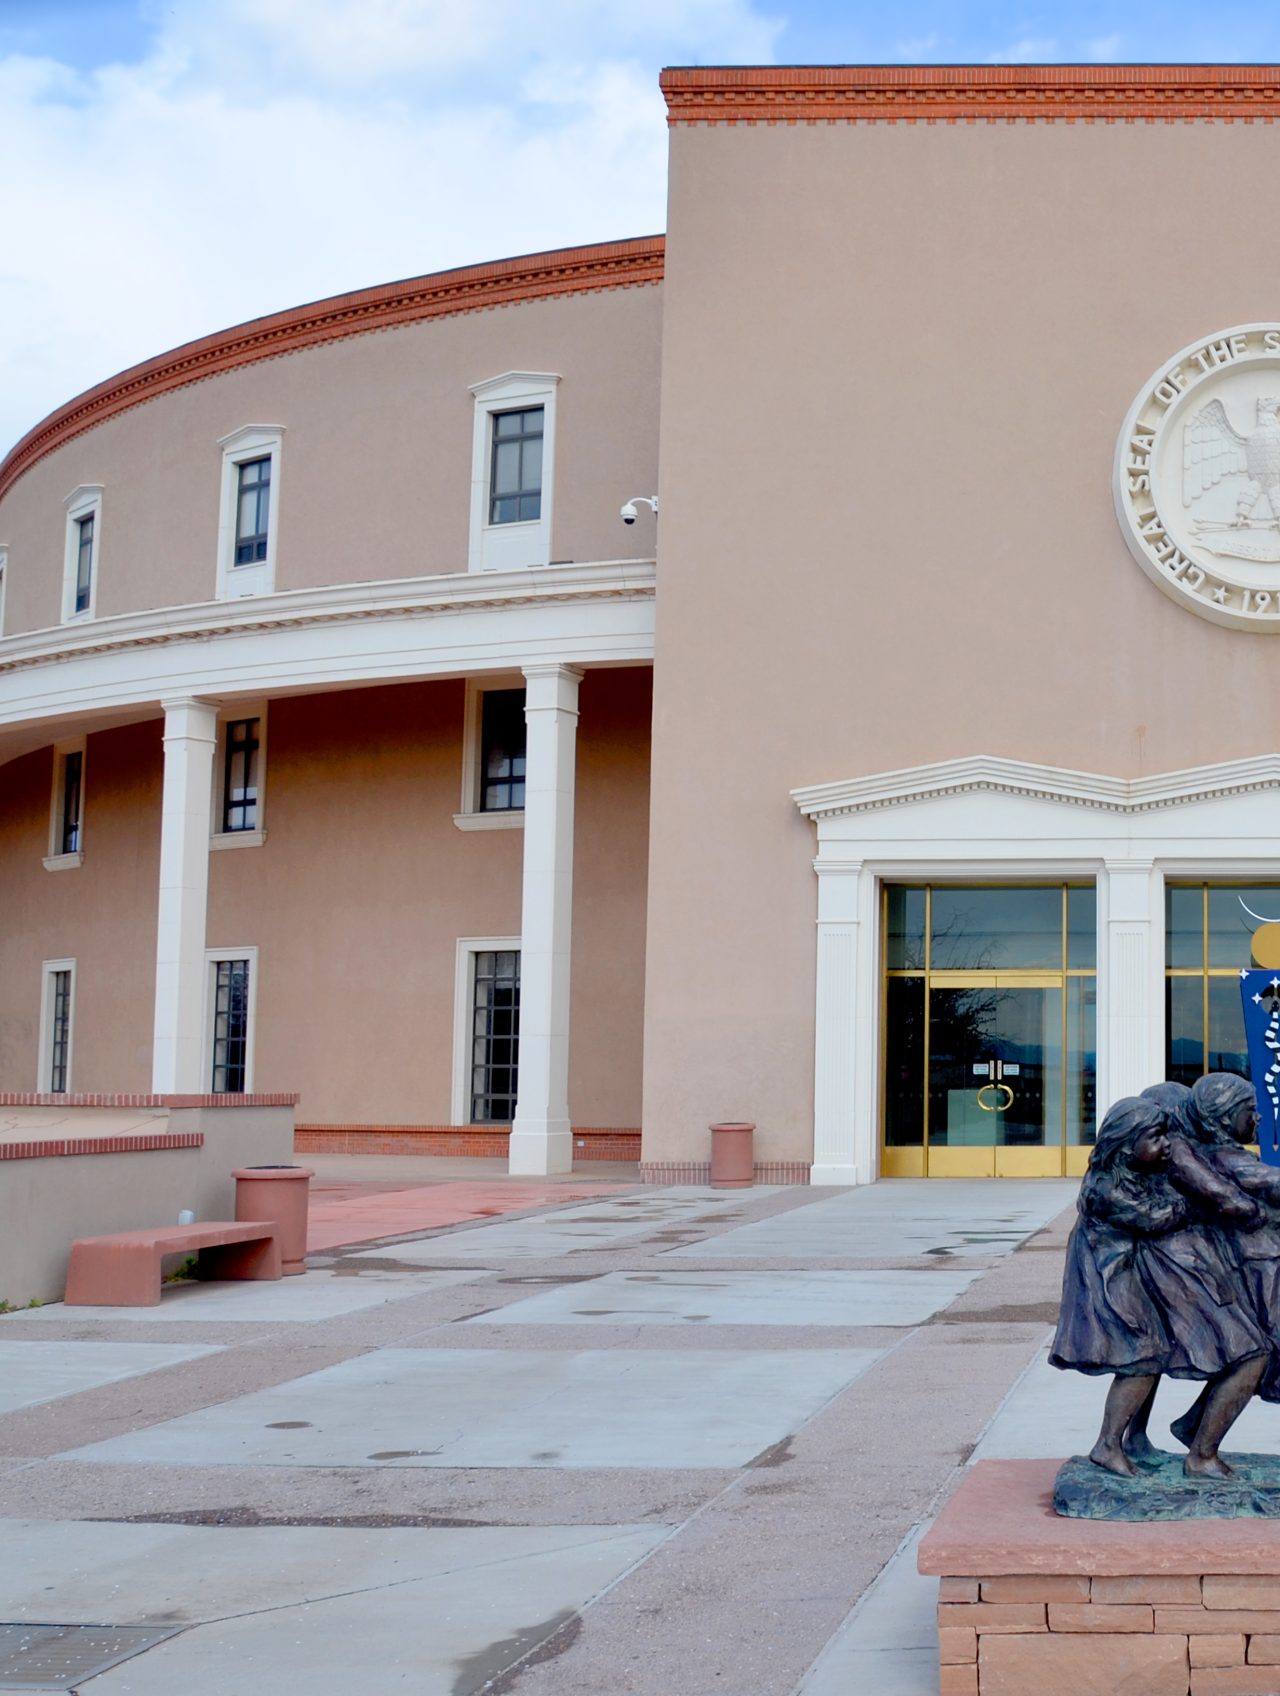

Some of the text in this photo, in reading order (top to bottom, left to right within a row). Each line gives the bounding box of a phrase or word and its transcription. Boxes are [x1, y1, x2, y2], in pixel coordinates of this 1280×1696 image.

[1190, 334, 1248, 372] THE
[1154, 366, 1187, 404] OF
[1127, 415, 1161, 494] SEAL
[1137, 507, 1206, 591] GREAT
